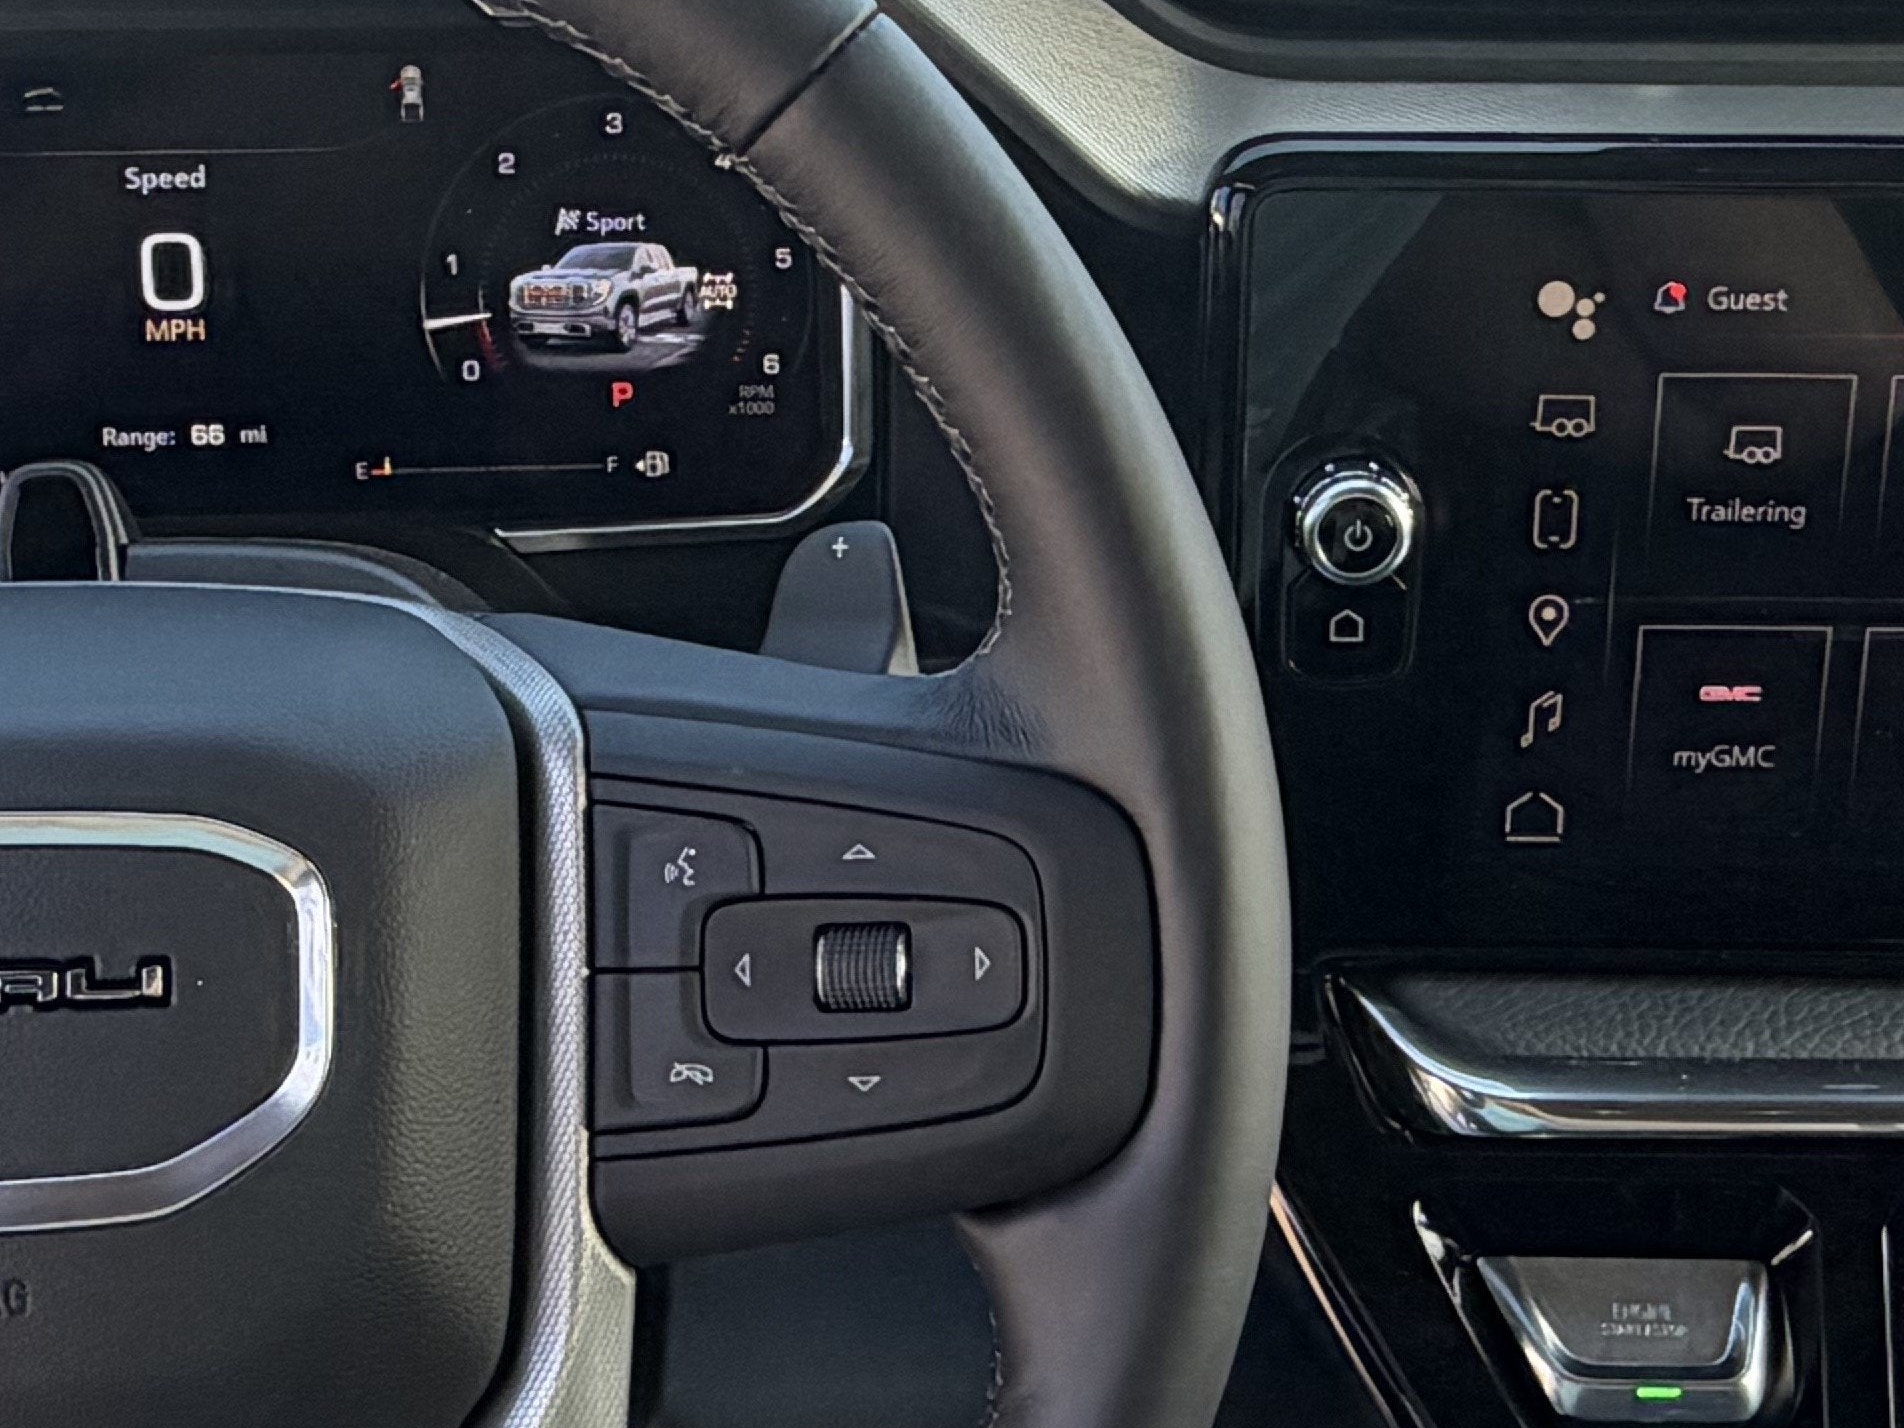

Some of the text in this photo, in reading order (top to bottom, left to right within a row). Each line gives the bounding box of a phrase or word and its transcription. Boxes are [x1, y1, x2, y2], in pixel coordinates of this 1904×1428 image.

[605, 113, 623, 134] 3
[498, 152, 516, 174] 2
[124, 164, 207, 195] Speed
[585, 211, 647, 236] Sport
[446, 254, 459, 275] 1
[774, 247, 793, 269] 5
[140, 231, 205, 312] 0
[1707, 286, 1789, 312] Guest
[145, 319, 207, 342] MPH
[462, 360, 480, 382] 0
[763, 354, 780, 375] 6
[612, 381, 634, 408] P
[738, 385, 775, 400] RPM
[728, 400, 775, 416] x1000
[101, 423, 269, 452] Range: 66 mi
[356, 461, 369, 479] E
[607, 456, 619, 473] F
[1686, 497, 1808, 529] Trailering
[1672, 744, 1777, 774] myGMC
